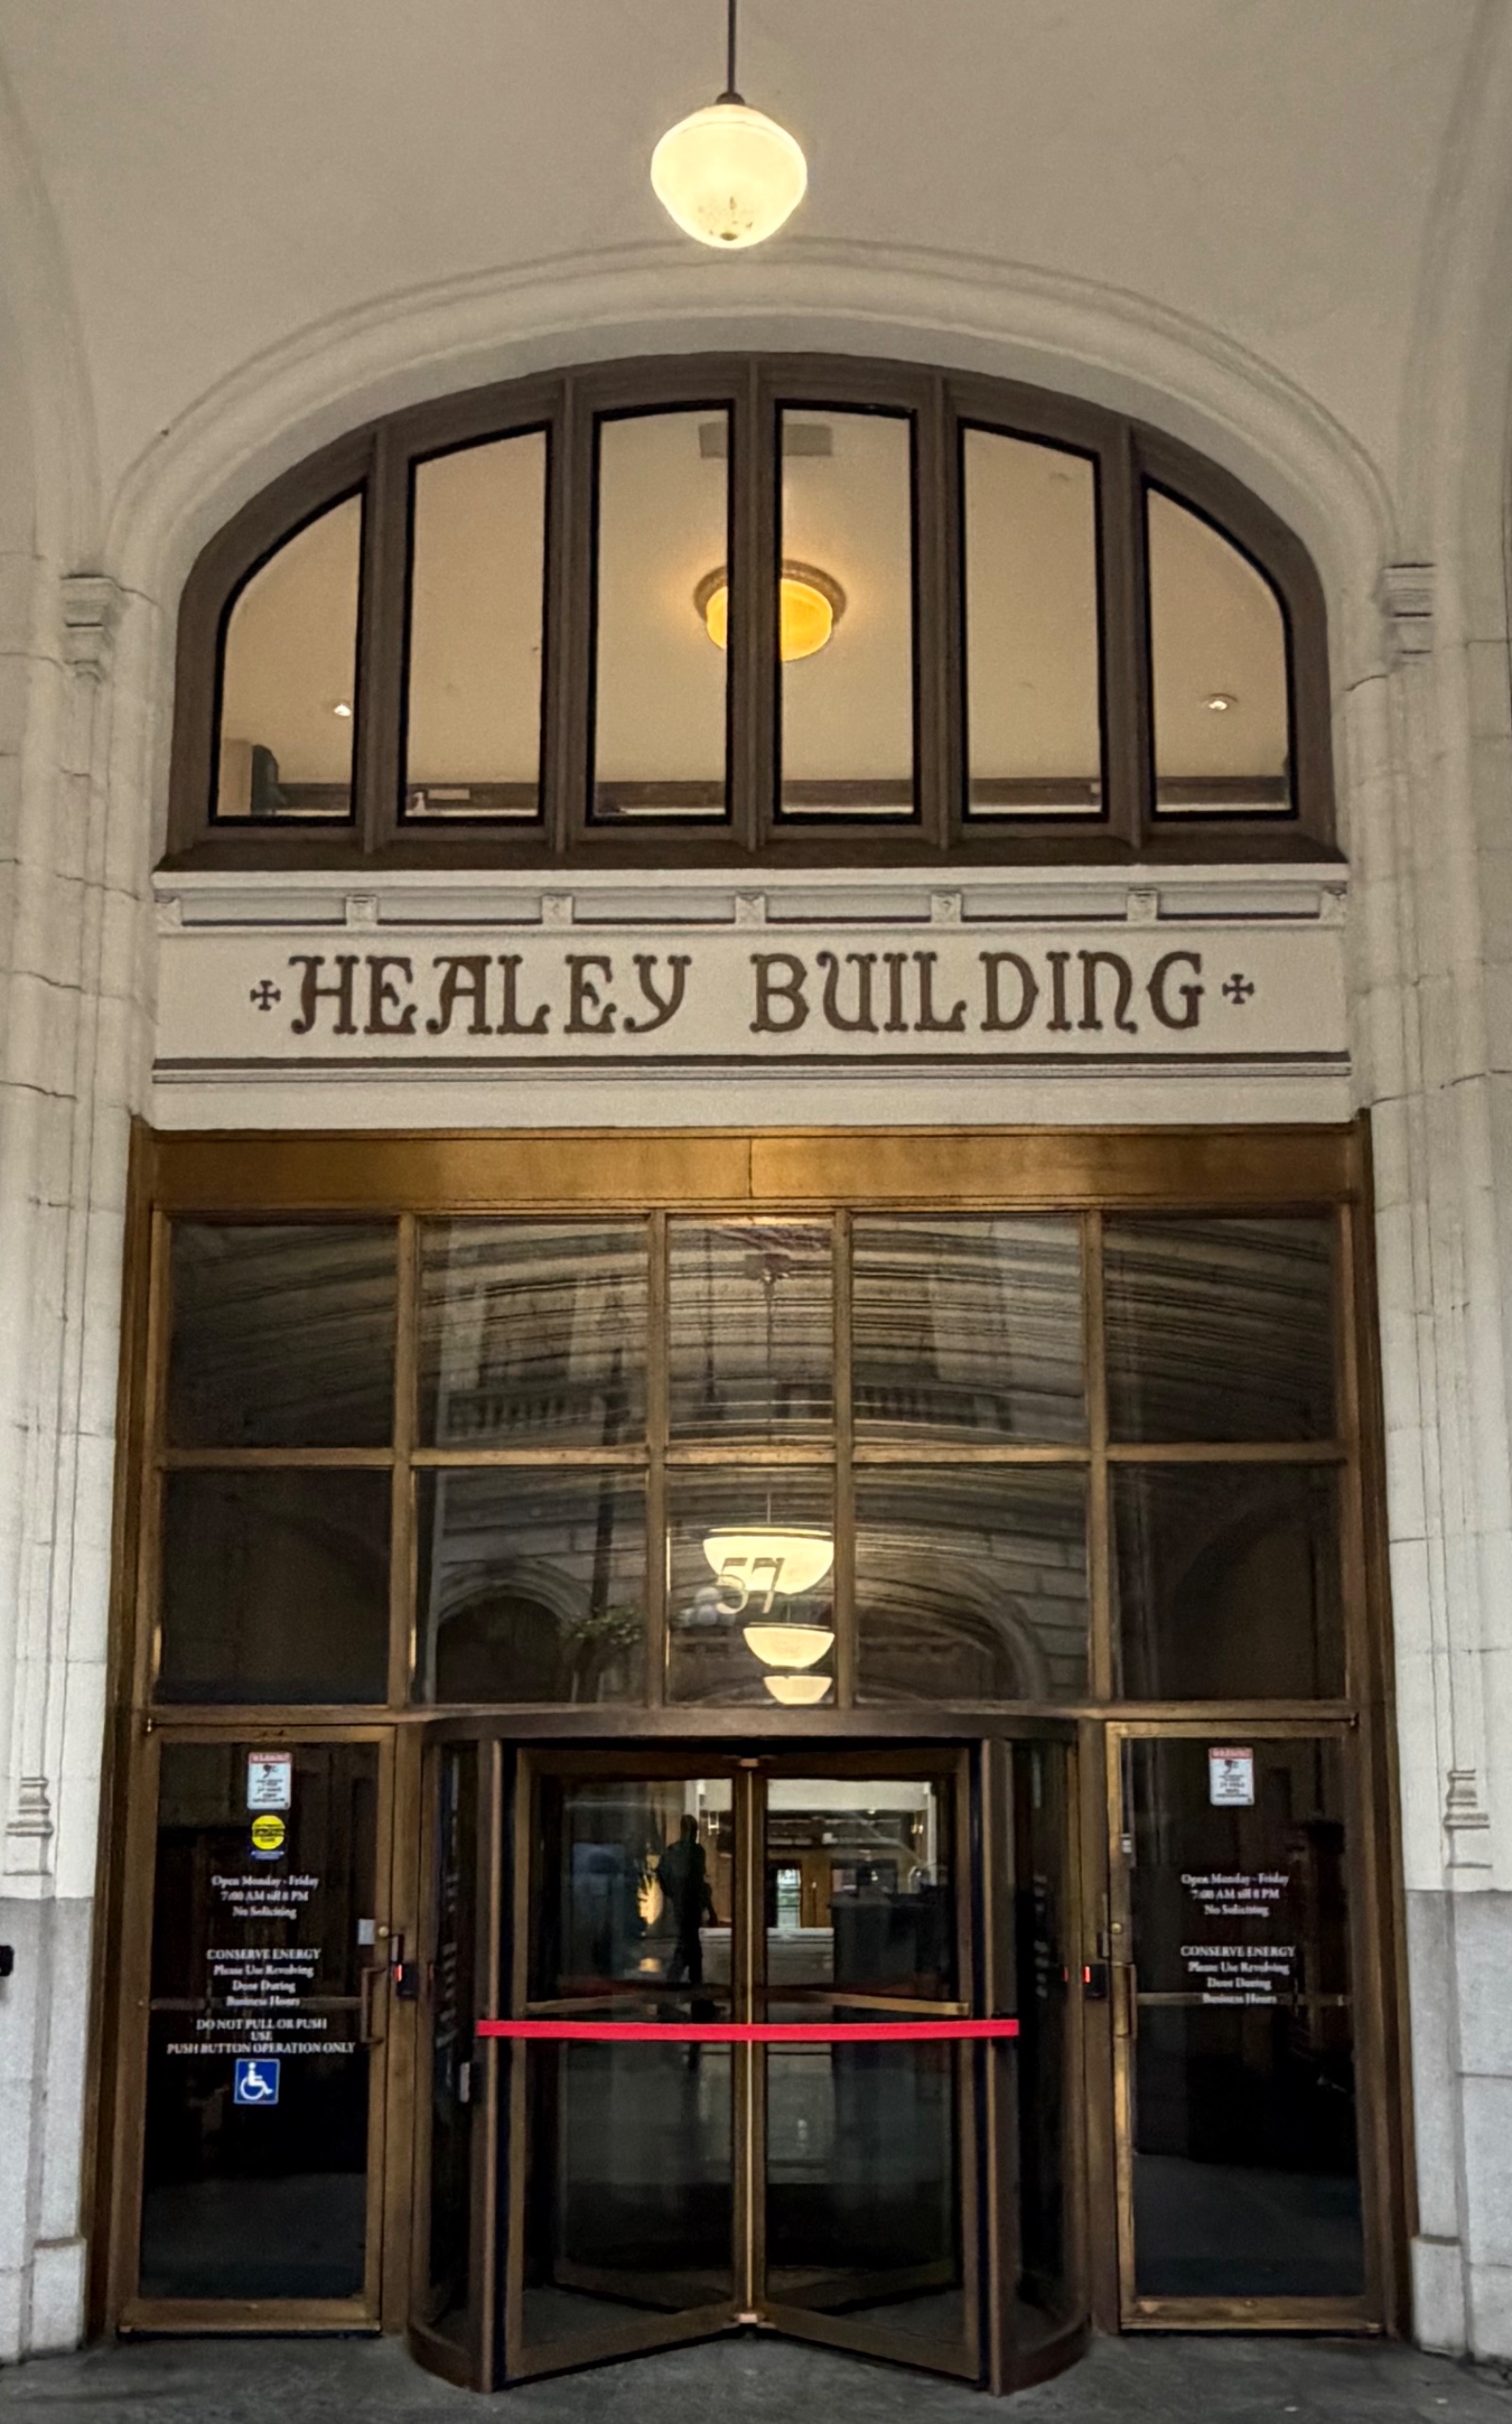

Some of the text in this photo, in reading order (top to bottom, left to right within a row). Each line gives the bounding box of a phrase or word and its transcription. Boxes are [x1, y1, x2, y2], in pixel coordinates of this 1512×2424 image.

[289, 950, 1203, 1036] HEALEY BUILDING
[715, 1557, 785, 1614] 57
[212, 1875, 239, 1888] Open
[242, 1875, 282, 1888] Monday
[289, 1875, 319, 1889] Friday
[1181, 1874, 1209, 1887] Open
[1211, 1873, 1250, 1886] Monday
[1258, 1872, 1289, 1886] Friday
[246, 1891, 265, 1901] AM
[291, 1891, 309, 1901] PM
[1216, 1889, 1236, 1900] AM
[1262, 1889, 1280, 1900] PM
[232, 1906, 249, 1917] No
[1205, 1904, 1221, 1916] No
[207, 1949, 320, 1960] CONSERVE ENERGY
[1181, 1946, 1295, 1957] CONSERVE ENERGY
[214, 1964, 314, 1979] Please Use Revolving
[1189, 1961, 1290, 1976] Please Use Revolving
[232, 1980, 296, 1994] Door During
[1208, 1977, 1271, 1991] Door During
[227, 1996, 301, 2006] Business Hours
[1203, 1993, 1277, 2003] Business Hours
[197, 2018, 327, 2030] DO NOT PULL OR PUSH
[250, 2031, 273, 2041] USE
[167, 2041, 356, 2054] PUSH BUTTON OPERATION ONLY
